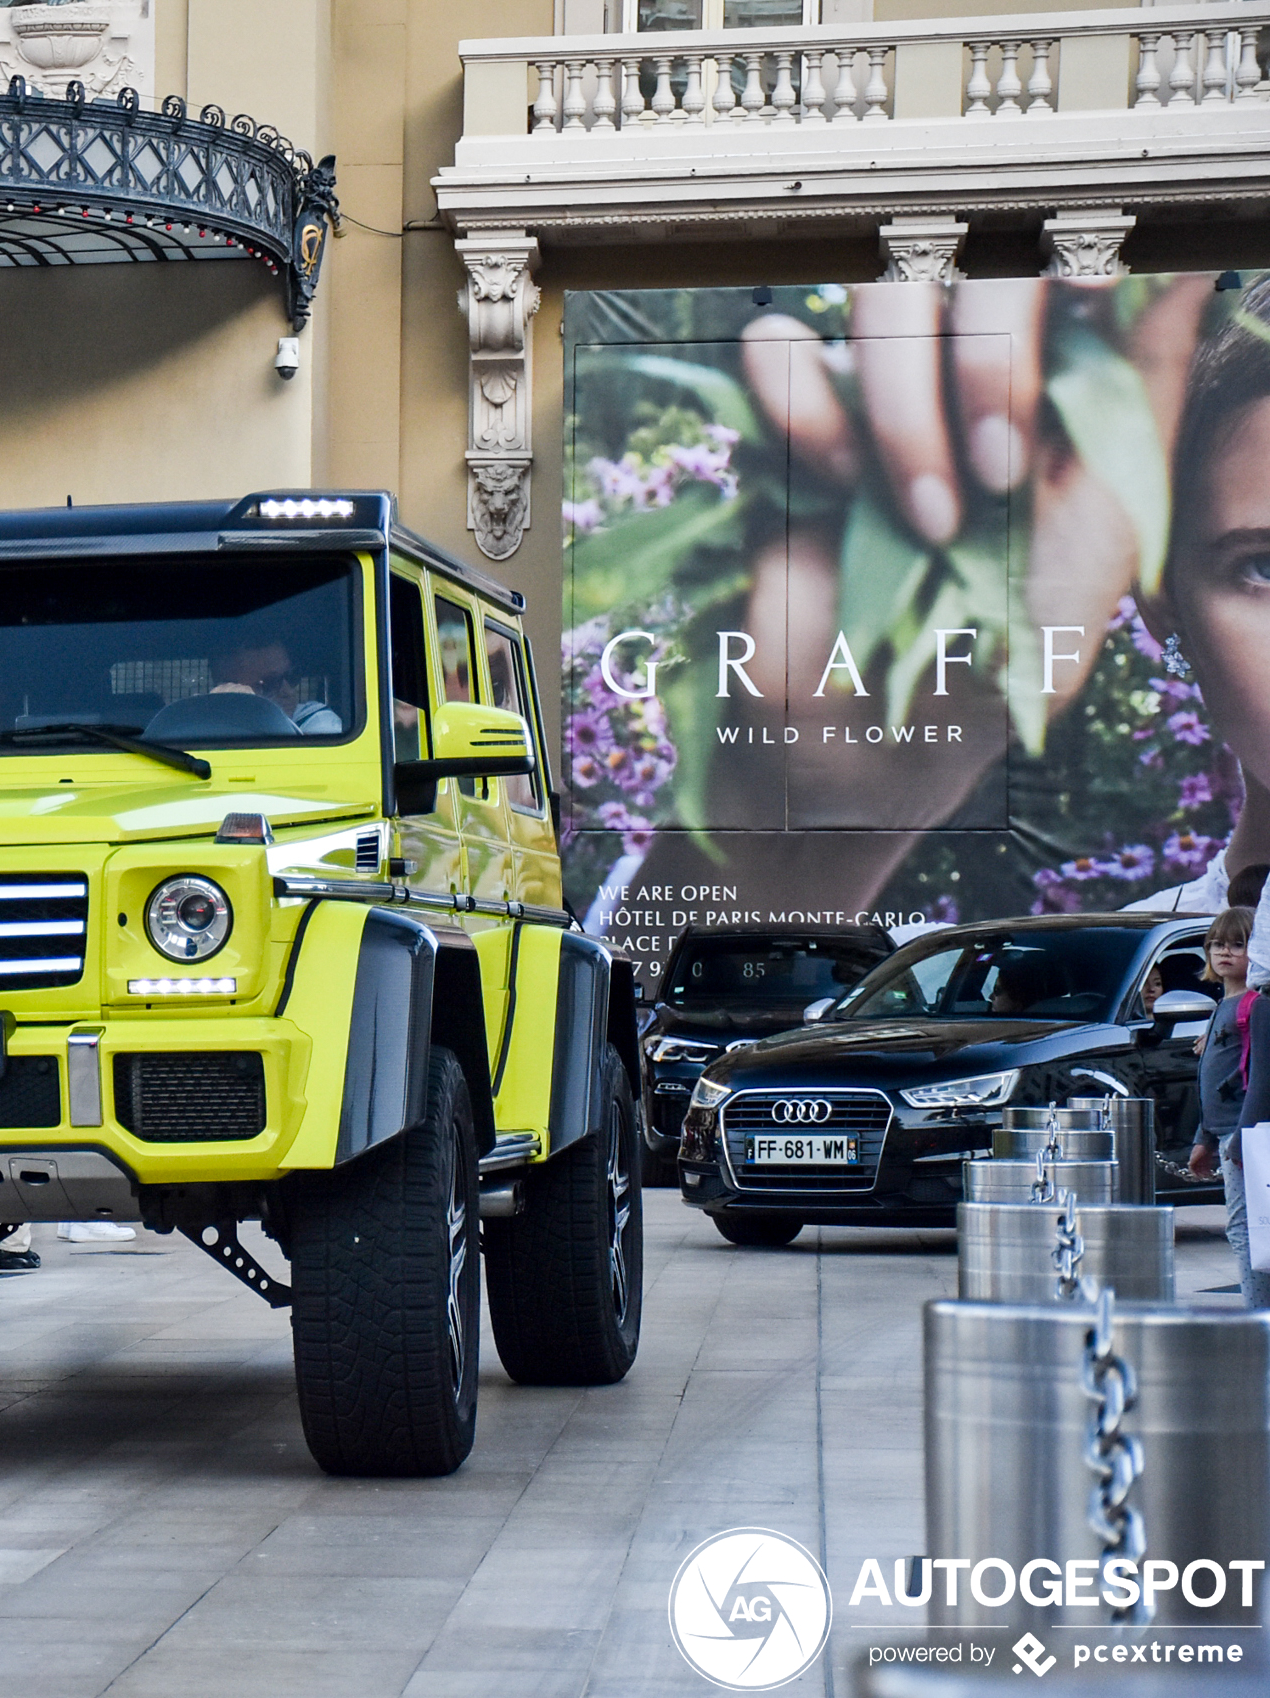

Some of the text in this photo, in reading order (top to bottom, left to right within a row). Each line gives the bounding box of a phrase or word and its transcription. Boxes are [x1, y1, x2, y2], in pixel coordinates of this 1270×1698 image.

[600, 625, 1086, 700] GRAFF
[716, 724, 963, 745] WILD FLOWER
[598, 885, 737, 901] WE ARE OPEN
[599, 907, 665, 926] HÔTEL
[672, 911, 698, 926] DE
[706, 911, 761, 926] PARIS
[748, 1149, 752, 1159] F
[757, 1140, 844, 1159] FF-681-WM
[847, 1150, 856, 1160] 06
